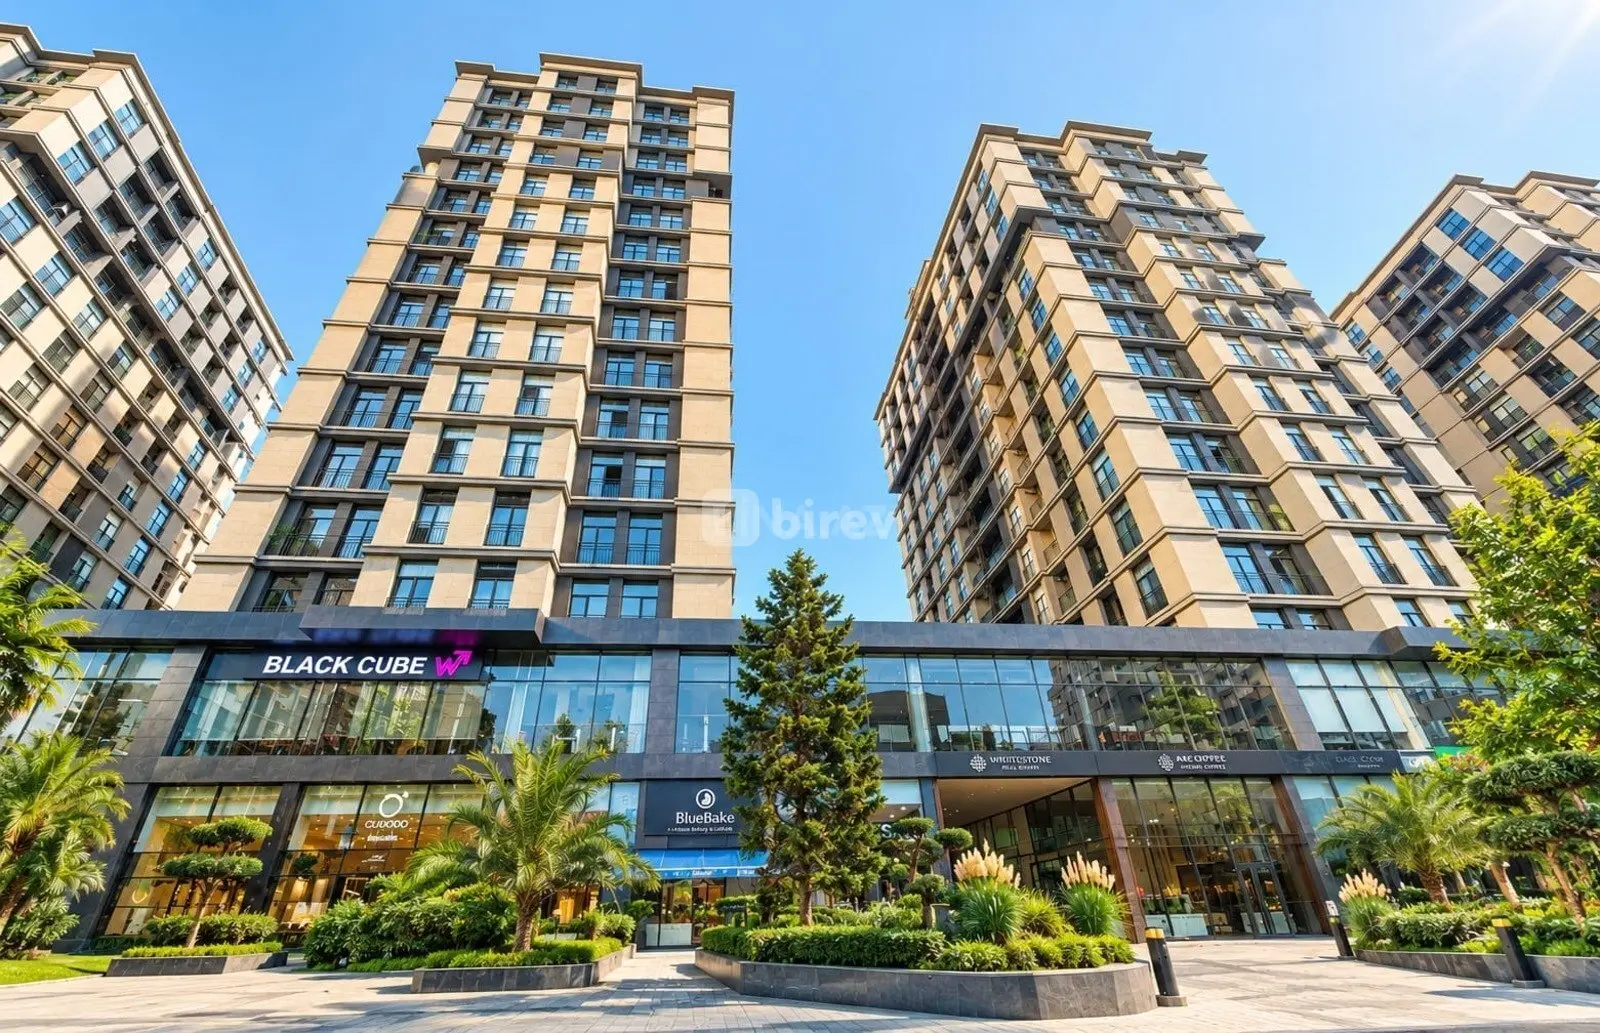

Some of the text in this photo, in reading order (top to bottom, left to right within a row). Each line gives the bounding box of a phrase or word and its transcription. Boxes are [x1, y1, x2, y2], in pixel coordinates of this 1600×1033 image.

[262, 655, 354, 675] BLACK
[357, 656, 428, 675] CUBE
[675, 811, 735, 824] BlueBake
